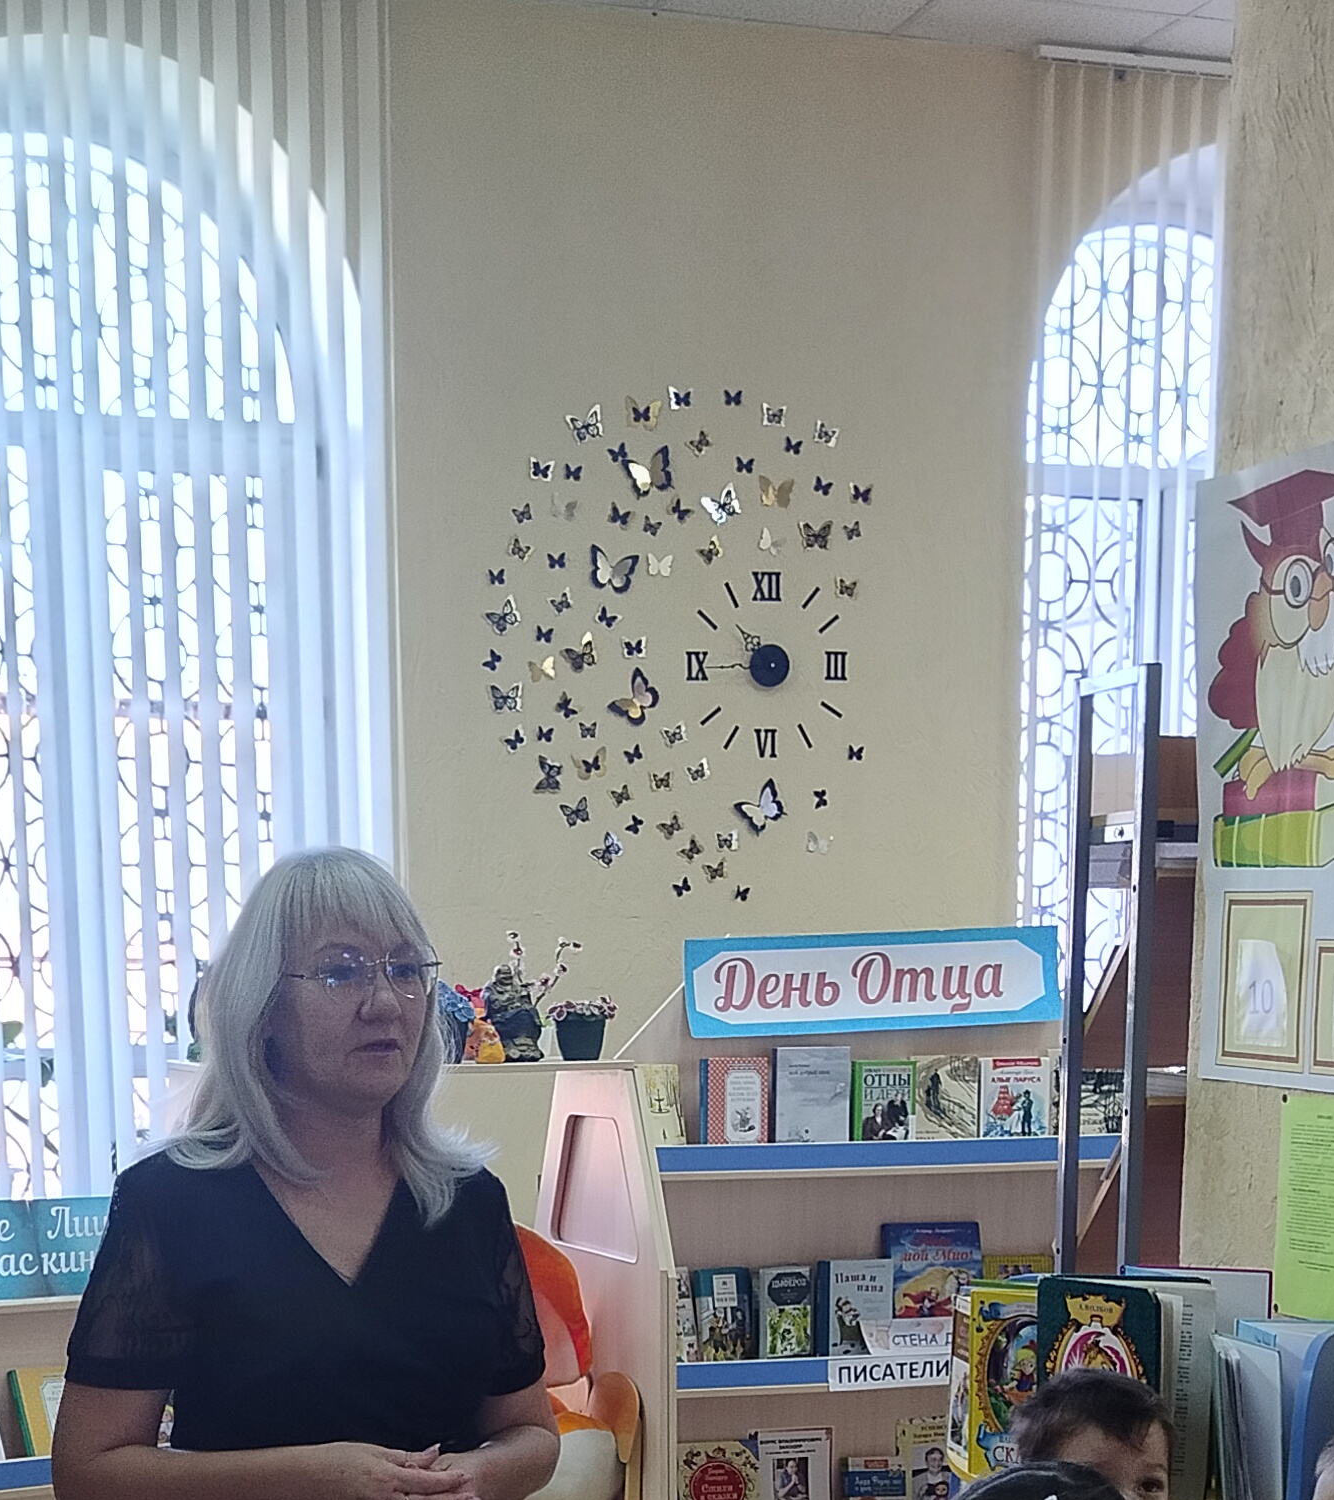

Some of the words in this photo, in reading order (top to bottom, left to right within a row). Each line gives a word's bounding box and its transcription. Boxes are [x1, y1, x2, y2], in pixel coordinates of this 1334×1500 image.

[751, 571, 782, 601] XII
[685, 651, 709, 681] IX
[824, 651, 848, 681] III
[754, 728, 777, 758] VI
[713, 956, 841, 1013] День
[851, 951, 1004, 1015] Отца
[1248, 980, 1274, 1015] 10
[863, 1073, 911, 1088] ОТЦЫ
[891, 1333, 938, 1346] СТЕНА
[838, 1360, 950, 1385] ПИСАТЕЛИ
